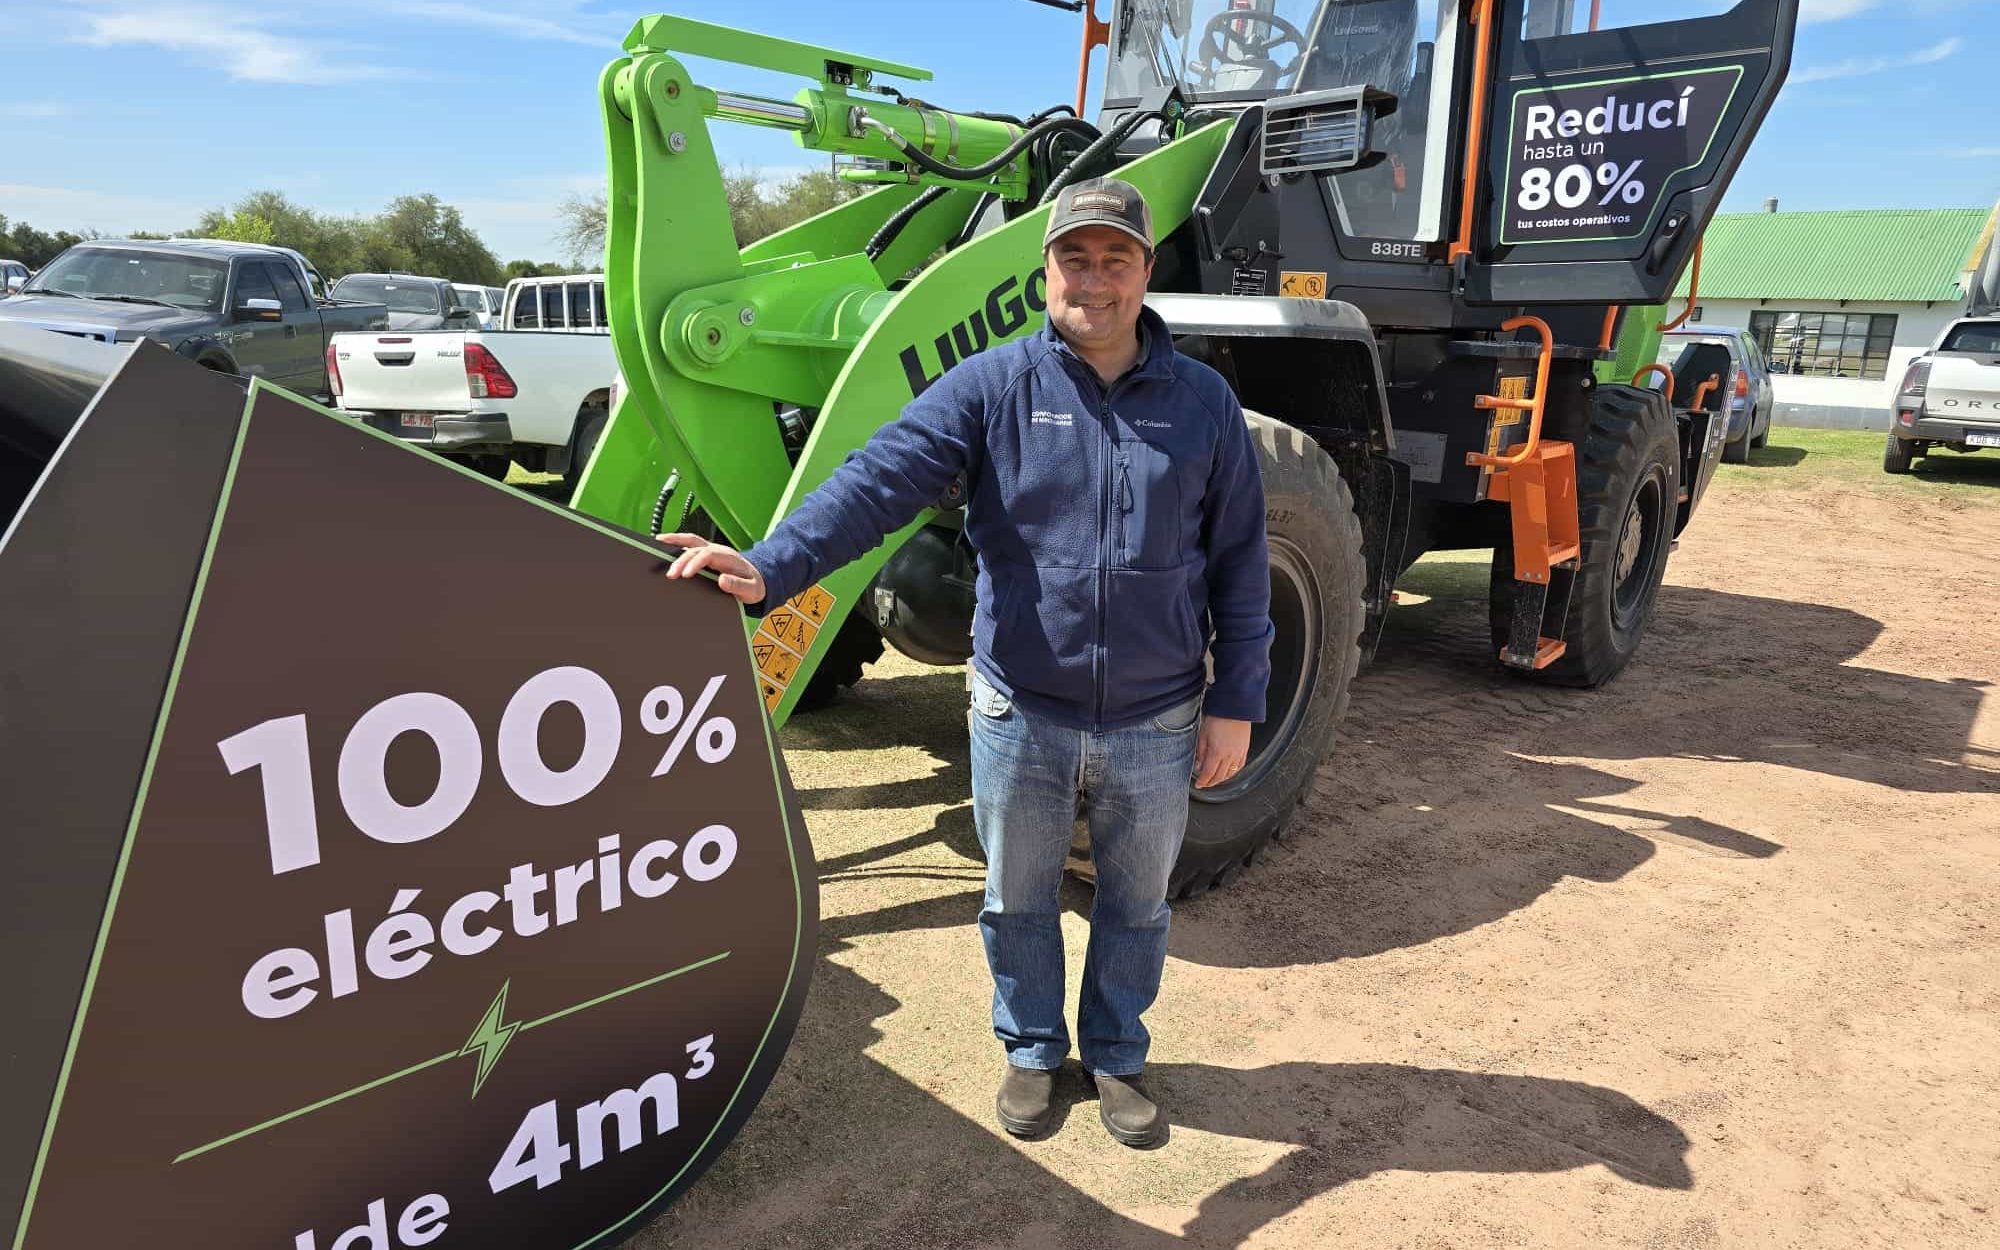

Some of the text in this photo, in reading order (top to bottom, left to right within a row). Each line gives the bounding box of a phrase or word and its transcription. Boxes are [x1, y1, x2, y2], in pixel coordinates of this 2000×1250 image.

[1525, 85, 1696, 142] Reducí
[1523, 141, 1605, 161] hasta un
[1517, 159, 1645, 211] 80%
[1517, 214, 1631, 229] tus costos operativos
[1371, 242, 1421, 257] 838TE
[217, 665, 738, 875] 100%
[241, 823, 739, 1020] eléctrico
